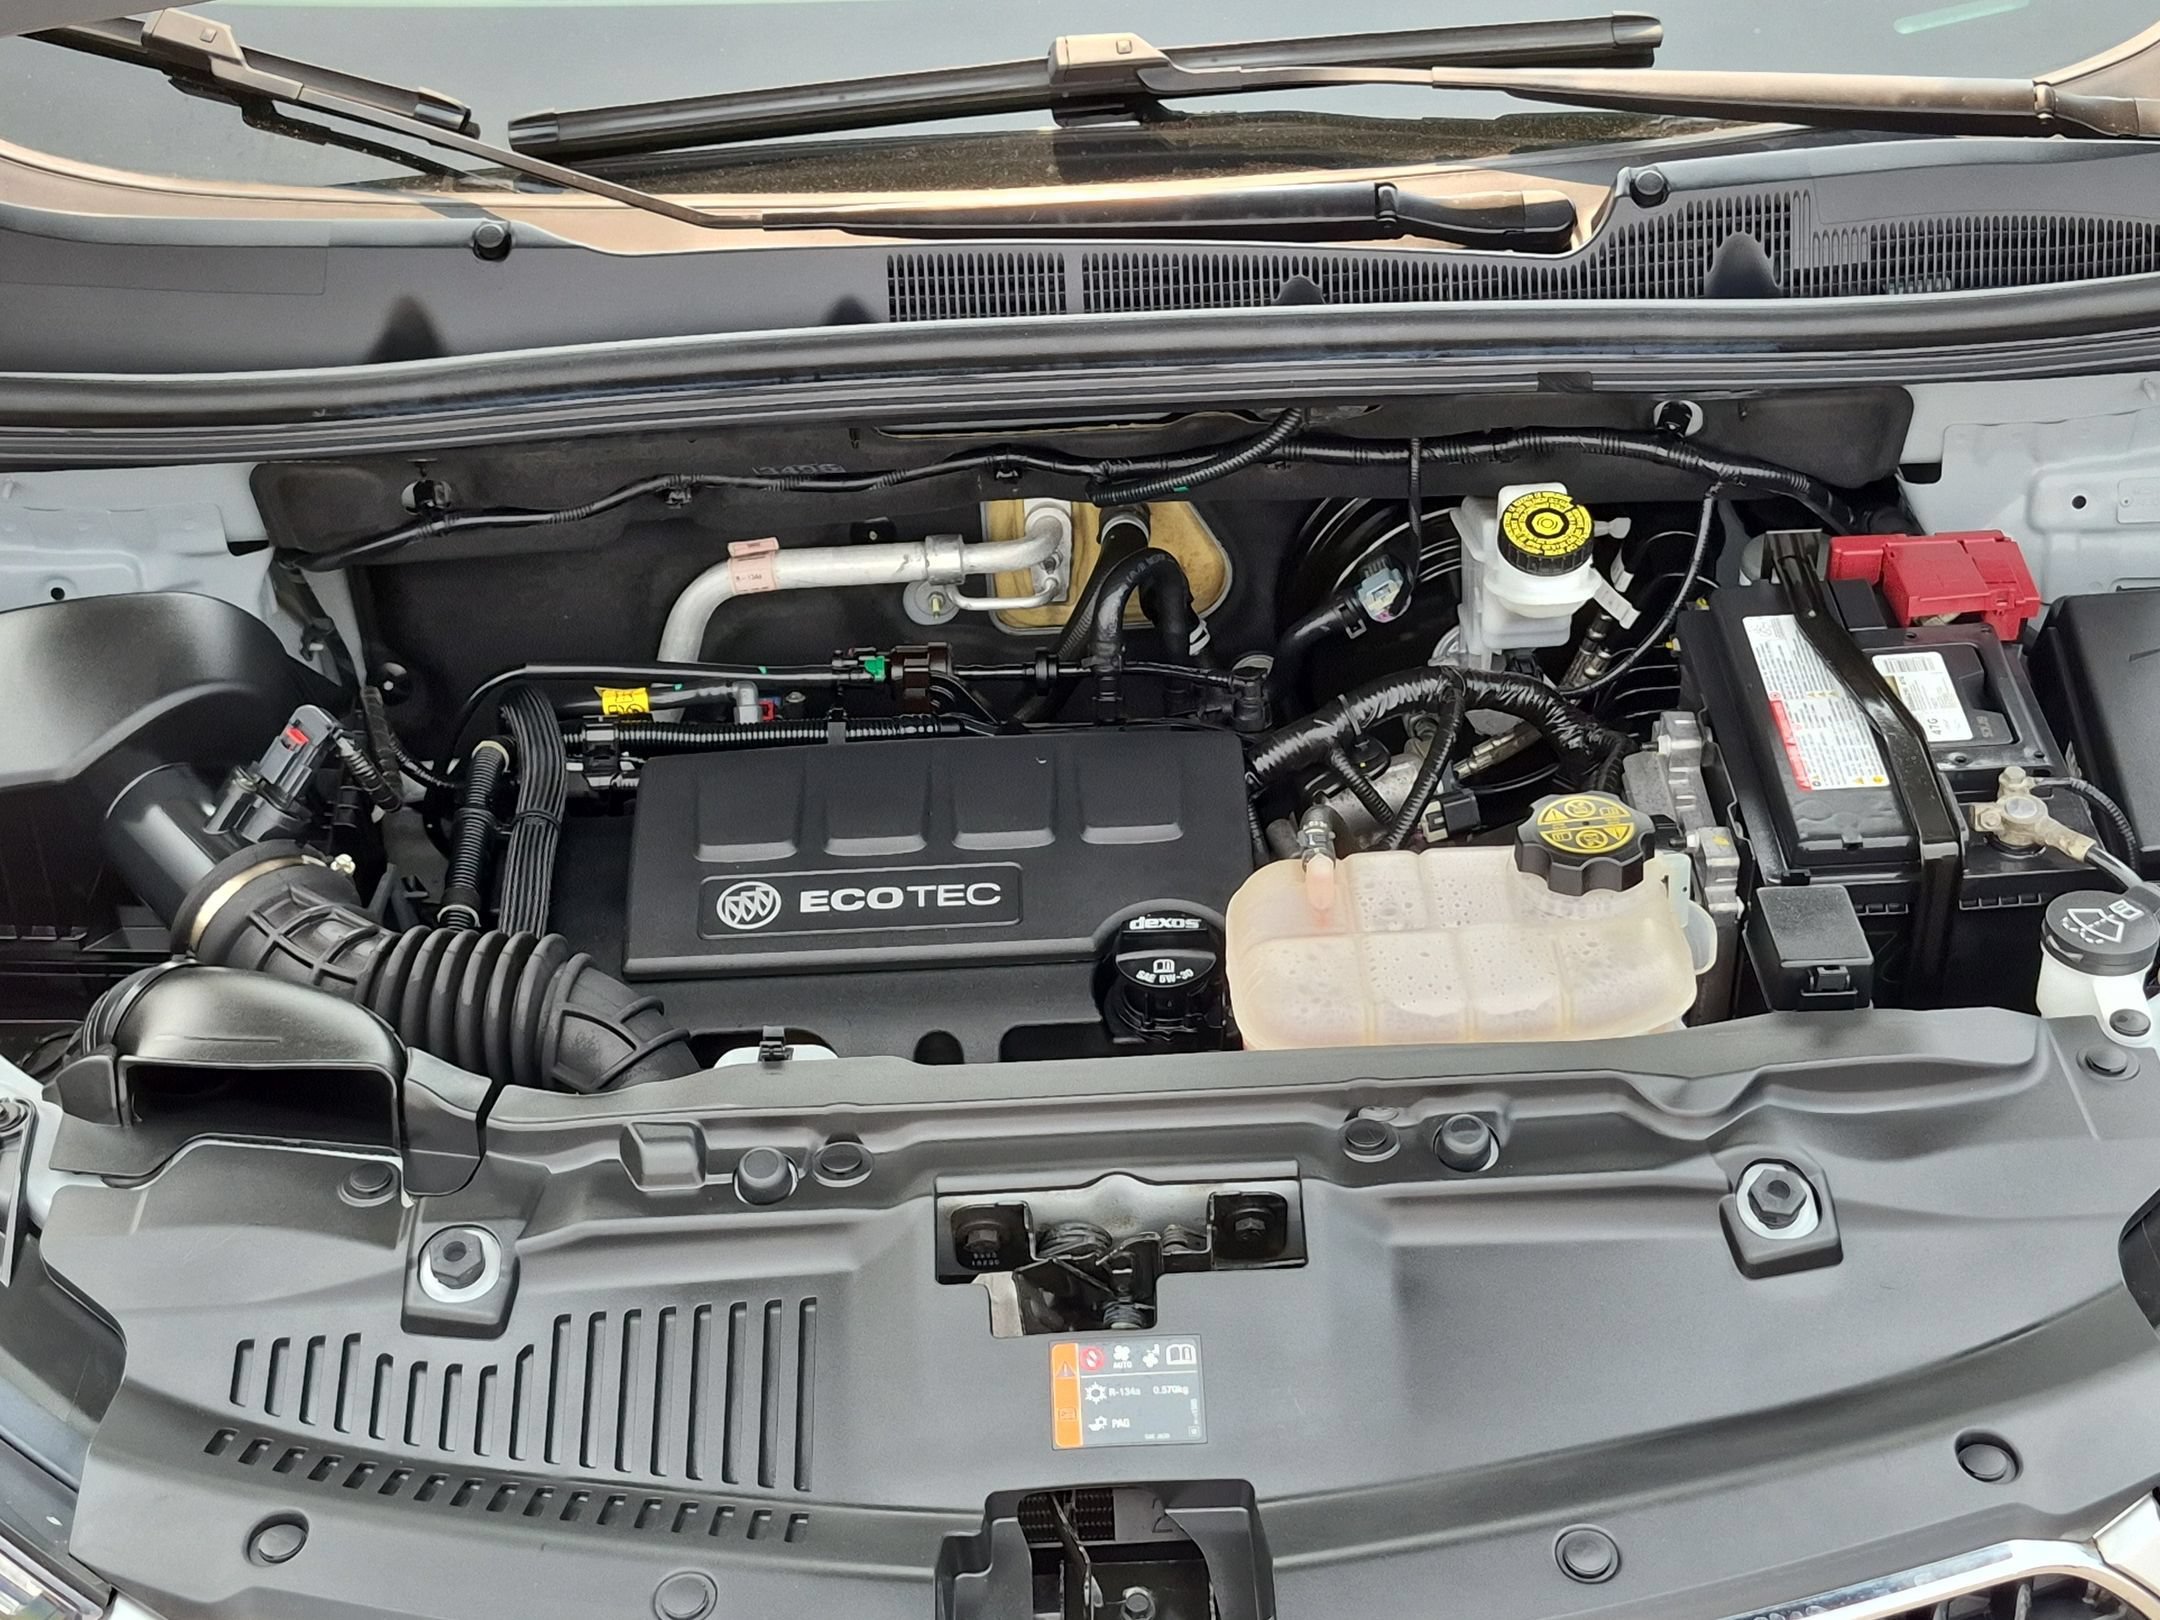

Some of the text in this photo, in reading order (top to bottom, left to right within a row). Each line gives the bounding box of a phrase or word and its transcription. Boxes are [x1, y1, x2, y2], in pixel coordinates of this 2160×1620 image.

[800, 883, 1001, 913] ECOTEC
[1129, 916, 1202, 930] dexos
[1136, 968, 1194, 984] SAE 5W-30
[1113, 1360, 1133, 1369] AUTO
[1108, 1386, 1141, 1397] R-134a
